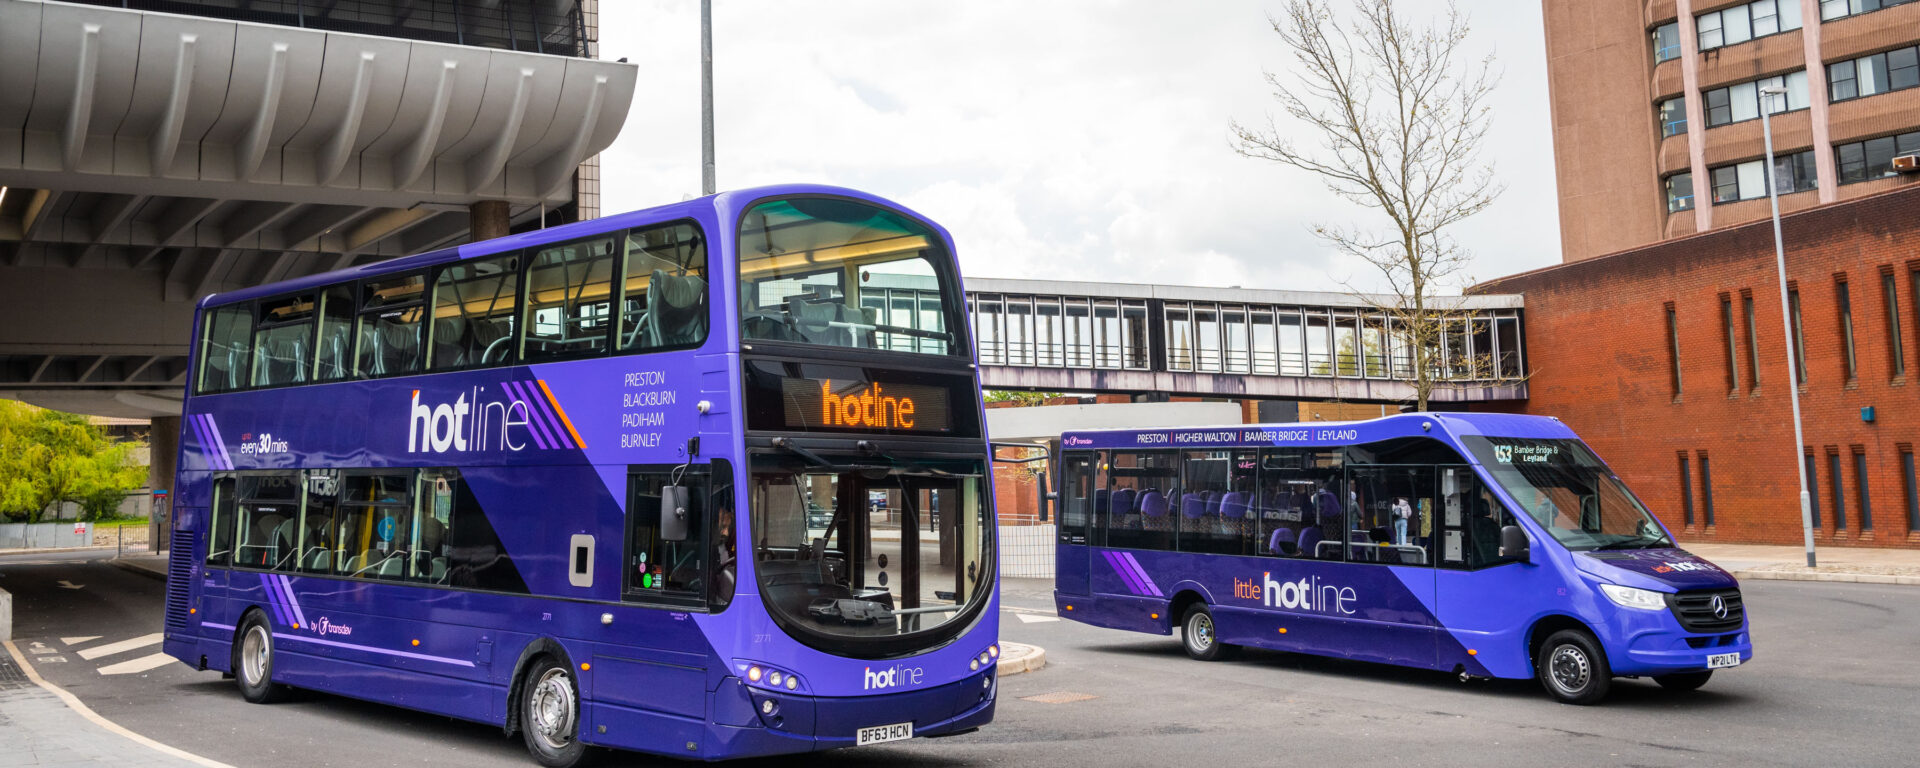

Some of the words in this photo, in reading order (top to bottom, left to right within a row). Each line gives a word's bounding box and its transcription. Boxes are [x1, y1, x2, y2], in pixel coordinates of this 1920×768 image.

[624, 371, 665, 387] PRESTON
[623, 390, 676, 408] BLACKBURN
[822, 378, 915, 428] hotline
[408, 385, 529, 453] hotline
[622, 412, 665, 428] PADIHAM
[621, 432, 662, 448] BURNLEY
[1137, 433, 1168, 444] PRESTON
[1175, 432, 1203, 443] HIGHER
[1204, 431, 1237, 442] WALTON
[1244, 431, 1277, 442] BAMBER
[1278, 430, 1308, 441] BRIDGE
[1317, 429, 1358, 441] LEYLAND
[241, 441, 259, 458] every
[258, 432, 272, 454] 30
[271, 437, 288, 453] mins
[1514, 445, 1534, 454] Bamber
[1535, 445, 1553, 456] Bridge
[1523, 454, 1548, 463] Leyland
[1234, 576, 1261, 600] little
[1263, 571, 1357, 615] hotline
[310, 620, 318, 633] by
[328, 622, 353, 636] transdev
[1711, 655, 1726, 667] WP21
[864, 663, 924, 690] hotline
[861, 726, 888, 743] BF63
[889, 723, 909, 739] HCN
